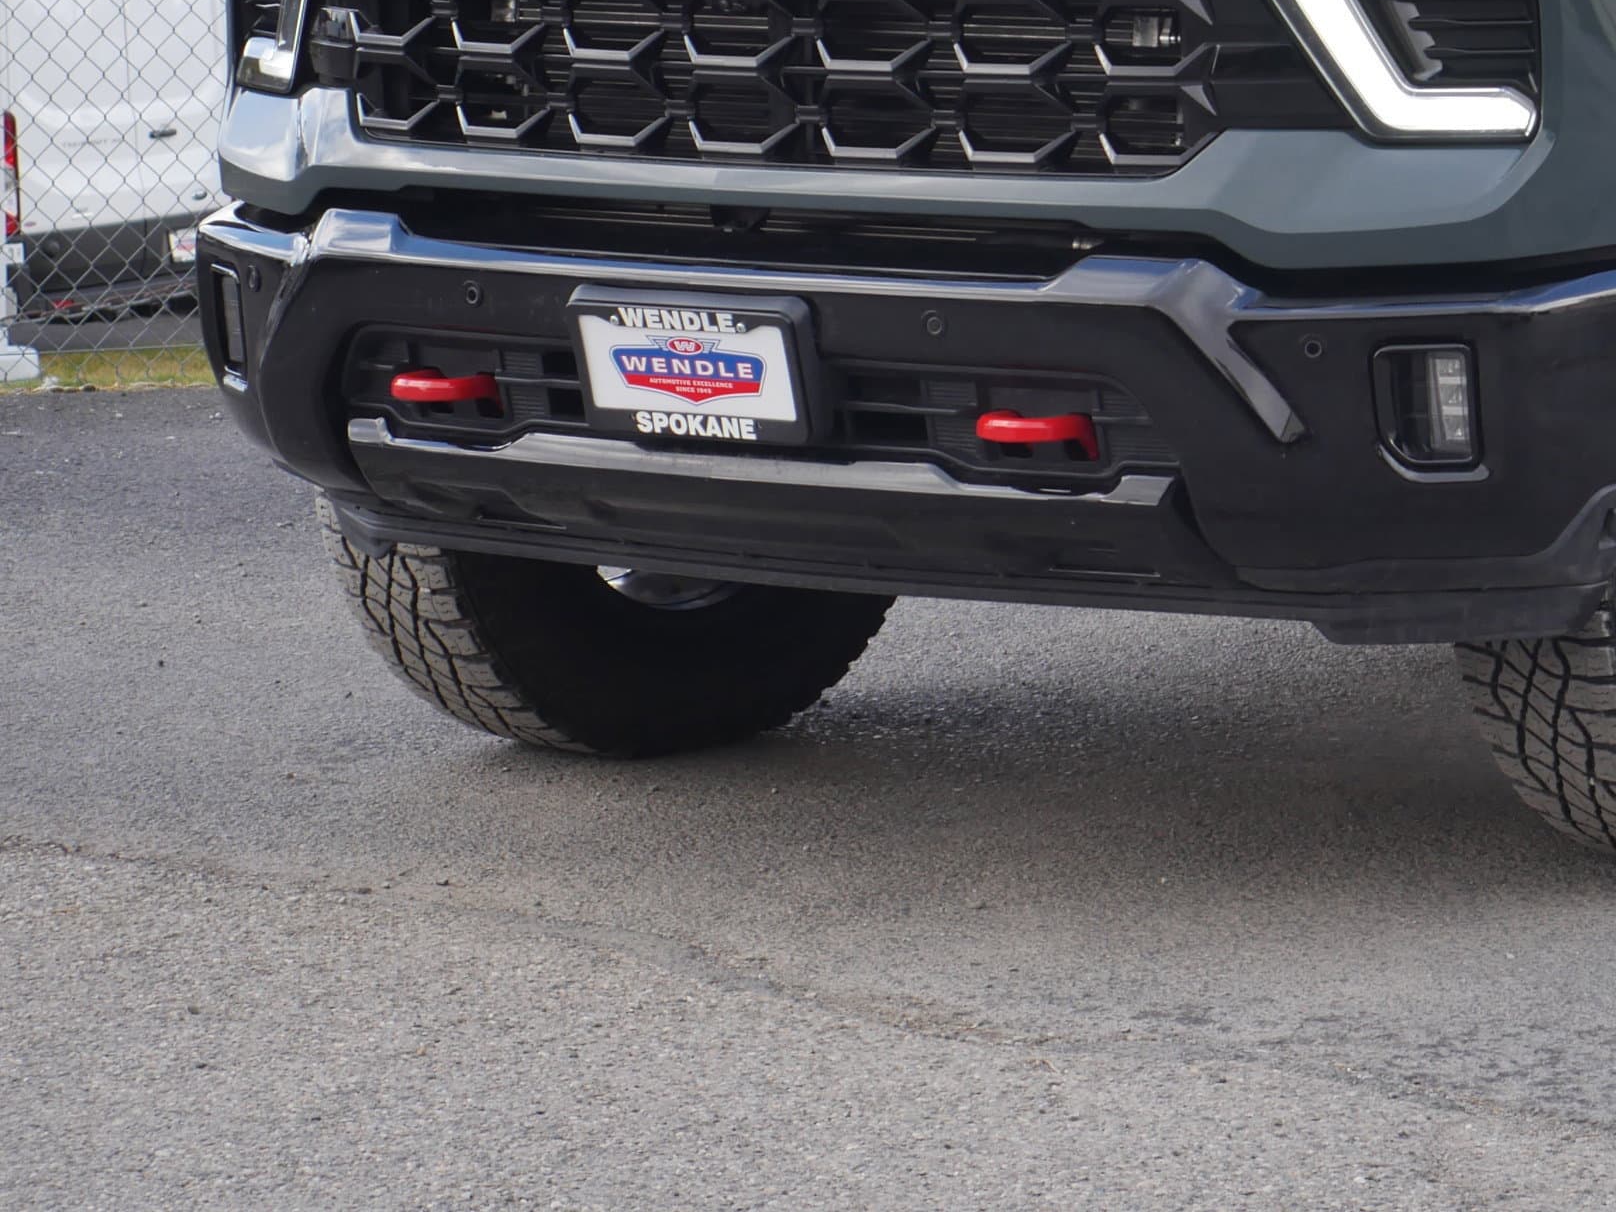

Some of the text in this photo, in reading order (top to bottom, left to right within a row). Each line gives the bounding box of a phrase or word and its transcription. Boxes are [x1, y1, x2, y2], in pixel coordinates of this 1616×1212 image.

[617, 307, 736, 333] WENDLE
[621, 355, 754, 379] WENDLE
[649, 377, 734, 389] AUTOMOTIVE EXCELLENCE
[636, 411, 757, 440] SPOKANE
